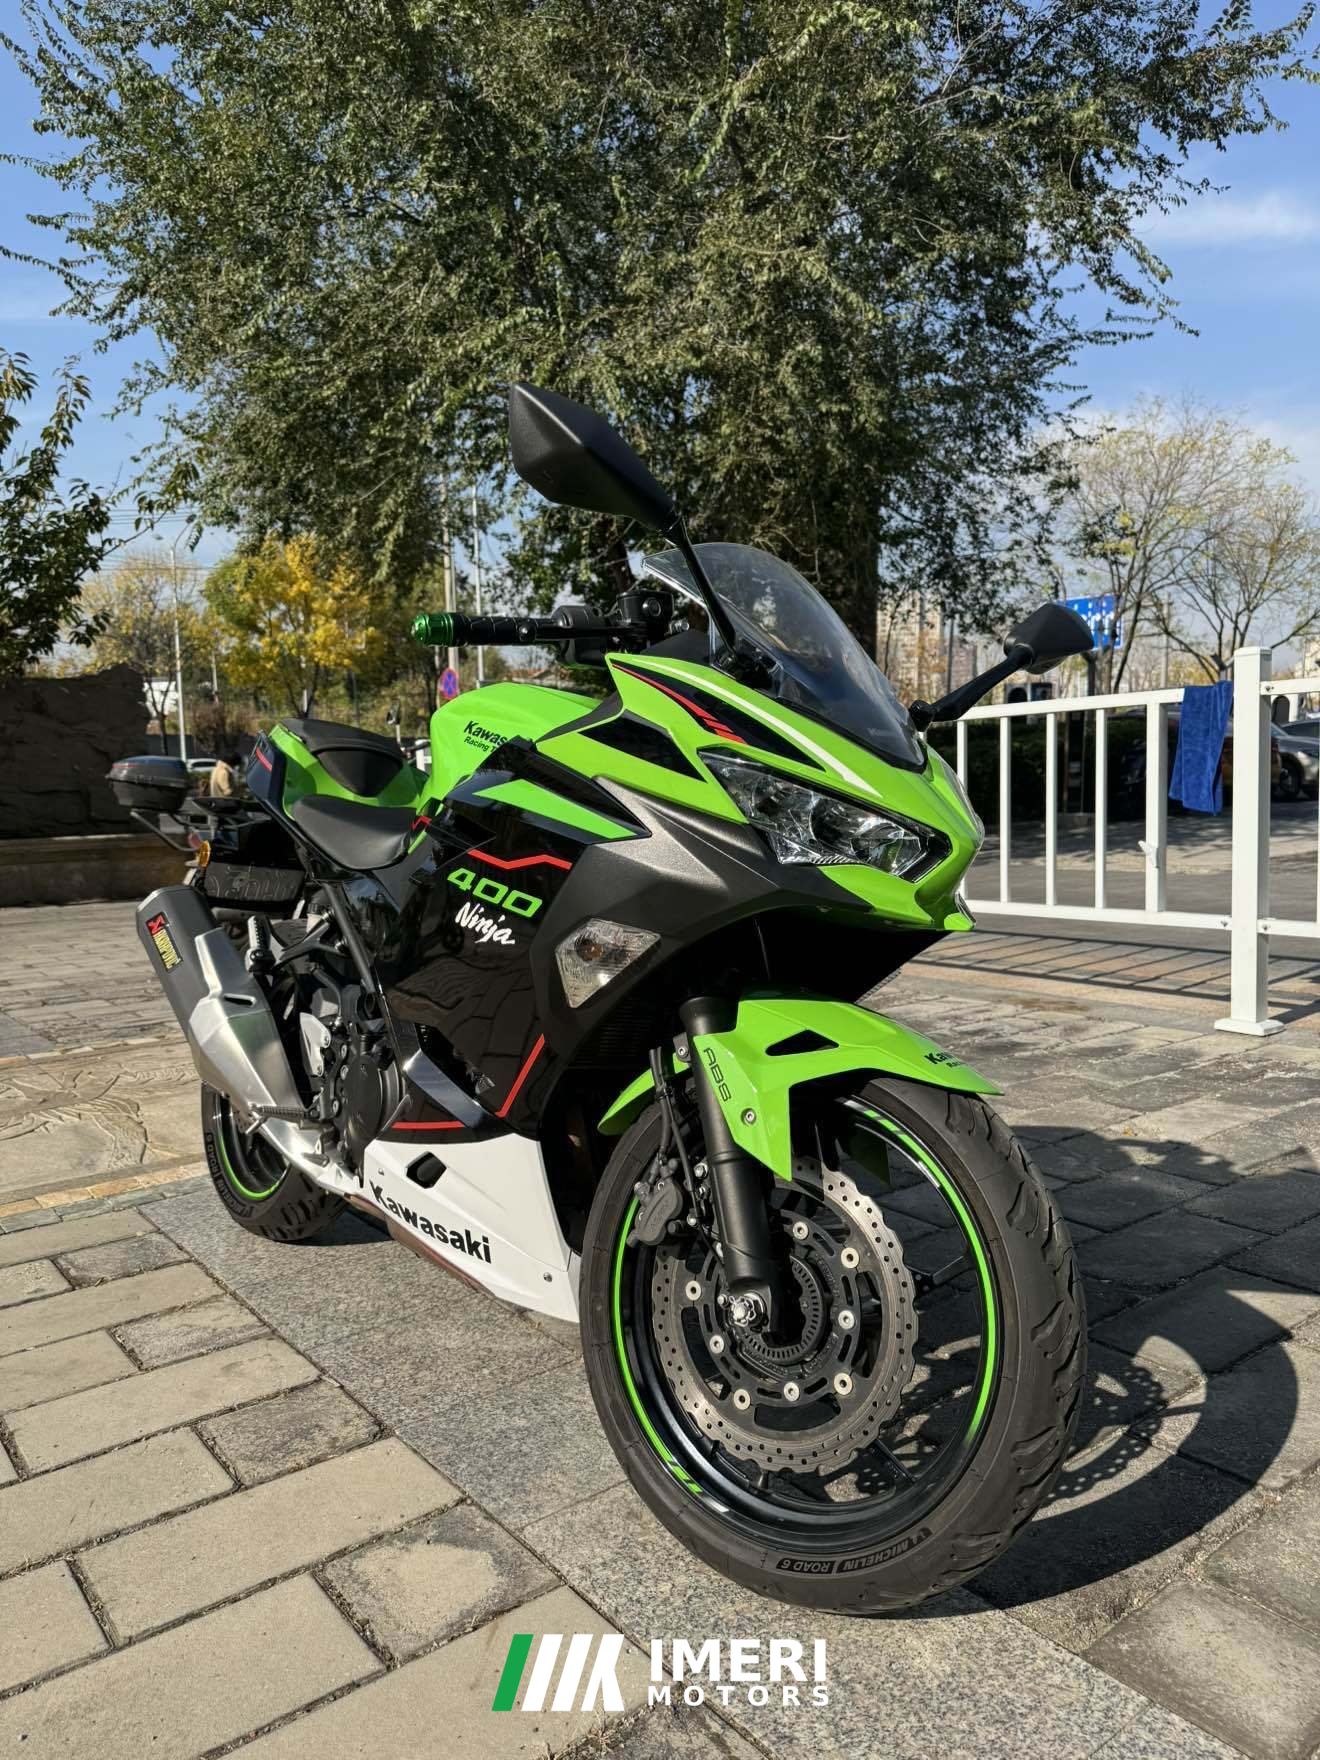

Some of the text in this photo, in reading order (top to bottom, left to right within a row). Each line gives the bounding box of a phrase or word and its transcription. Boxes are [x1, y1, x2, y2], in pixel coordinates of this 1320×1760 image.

[464, 736, 490, 752] Racing
[447, 867, 543, 918] 400
[455, 902, 516, 945] Ninja
[703, 1047, 732, 1102] ABS
[369, 1179, 492, 1264] Kawasaki
[781, 1539, 908, 1573] MICHELIN ROAD 6
